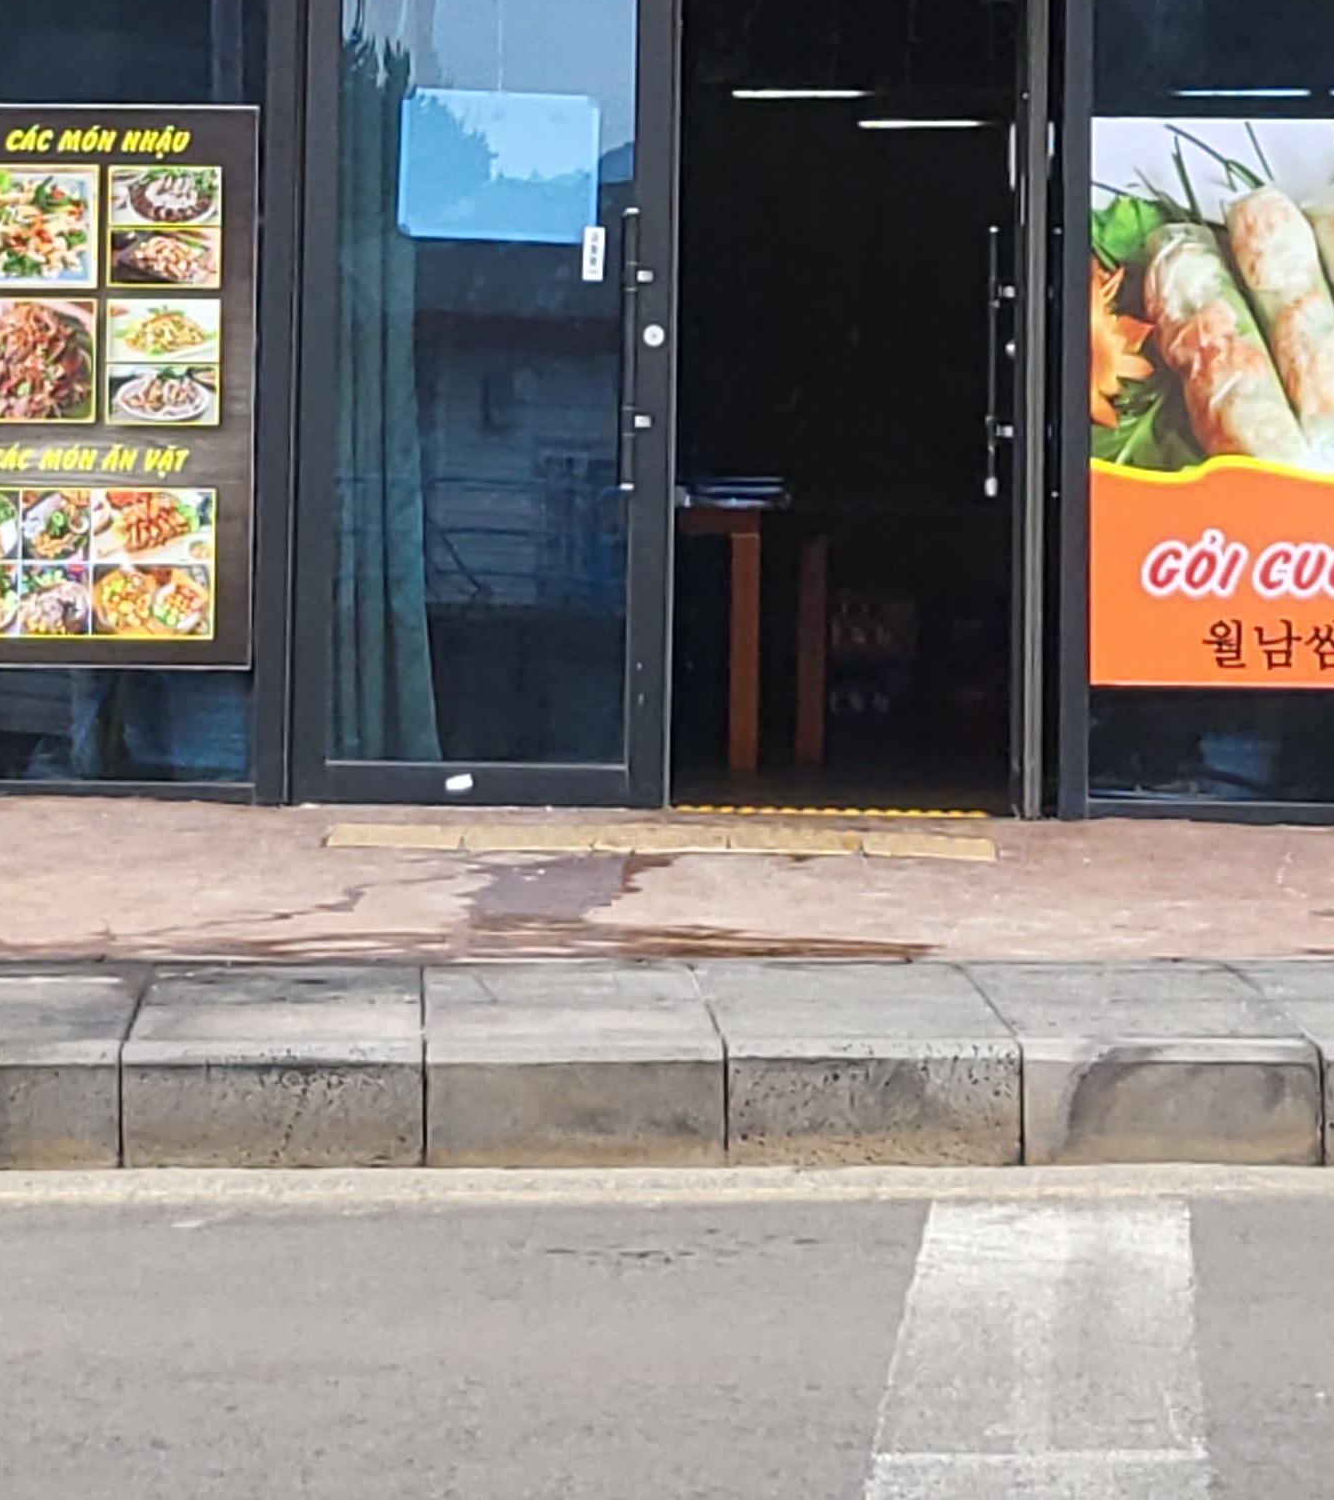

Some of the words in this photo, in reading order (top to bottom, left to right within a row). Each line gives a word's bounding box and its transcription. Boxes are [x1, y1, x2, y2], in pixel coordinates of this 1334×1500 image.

[4, 124, 54, 152] CÁC
[56, 125, 118, 153] MÓN
[38, 444, 99, 472] MÓN
[1144, 530, 1247, 595] GỎI
